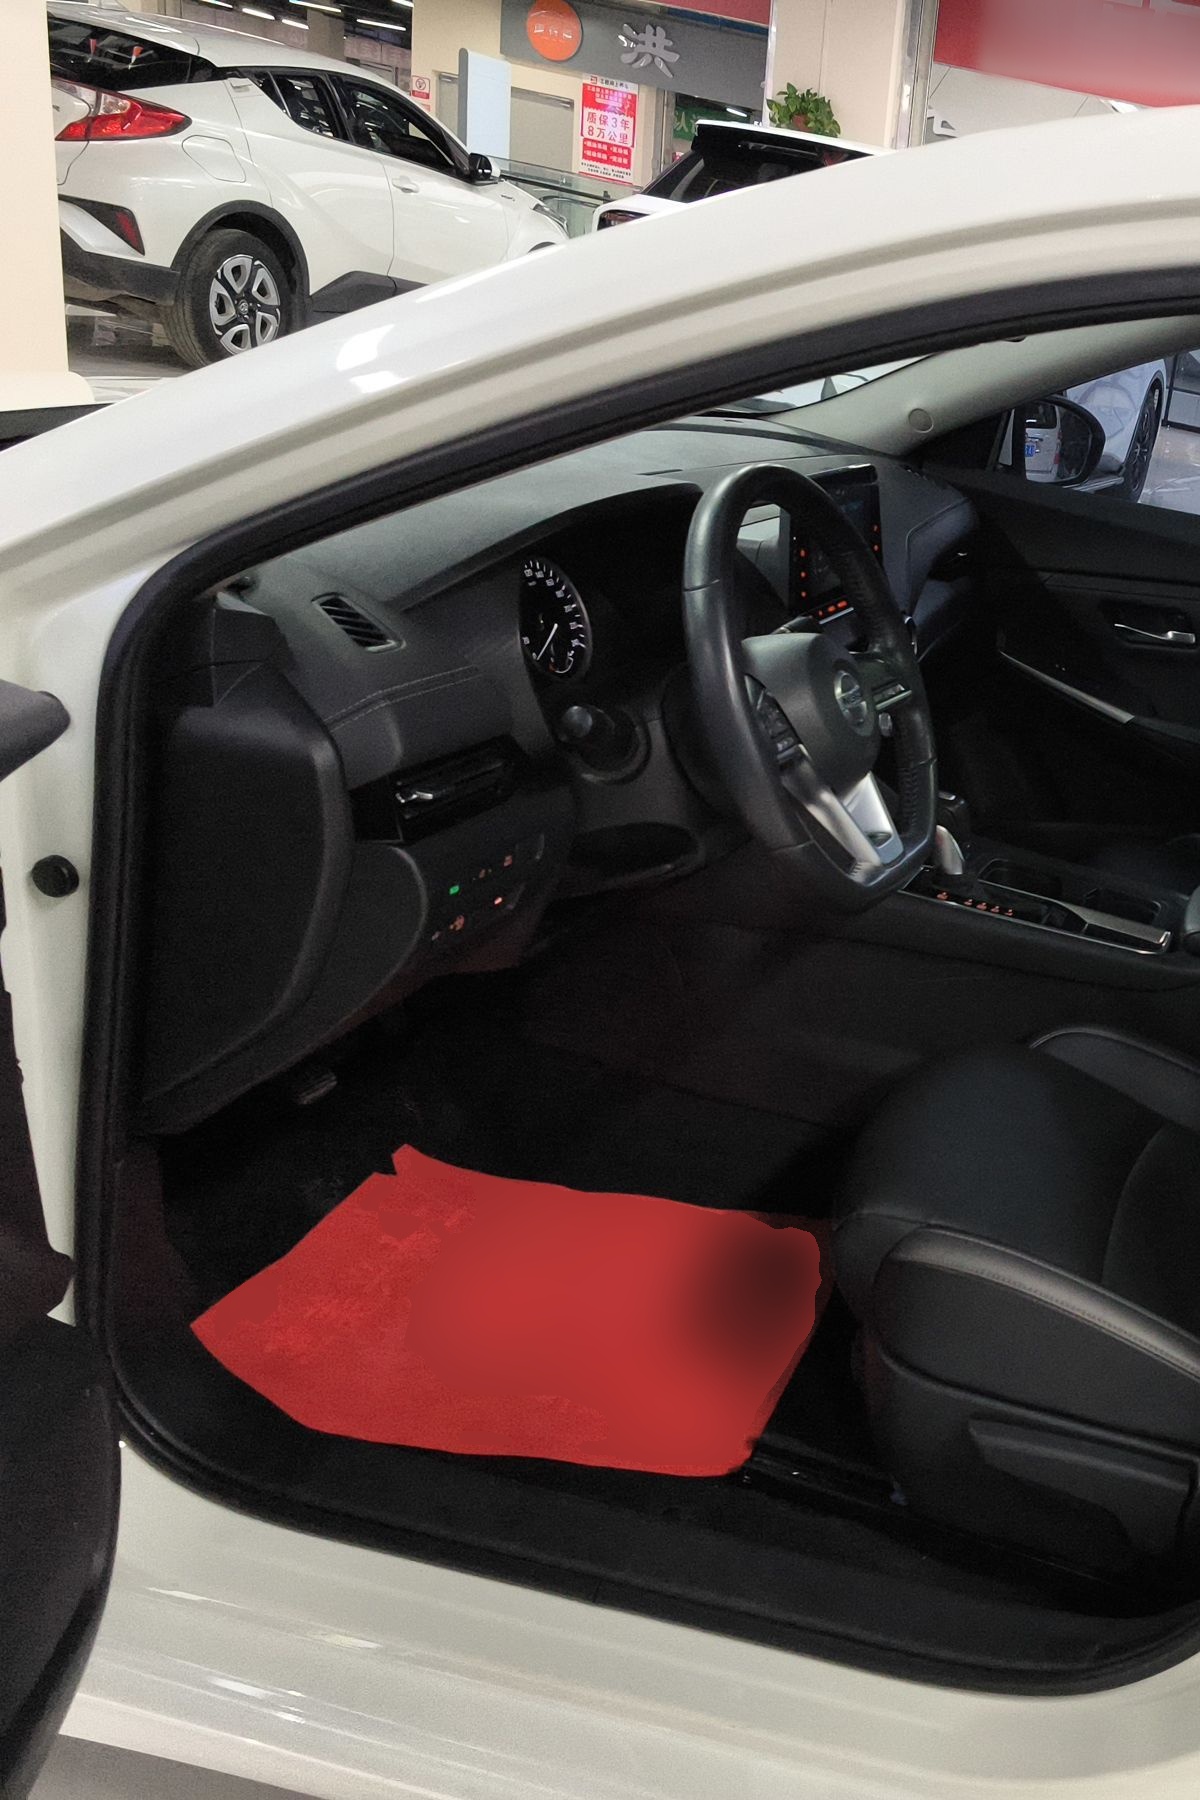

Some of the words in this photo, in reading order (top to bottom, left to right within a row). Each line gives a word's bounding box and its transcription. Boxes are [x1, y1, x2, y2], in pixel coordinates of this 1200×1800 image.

[618, 23, 680, 78] 洪
[587, 112, 630, 131] 质保3年
[586, 126, 629, 145] 8万公里
